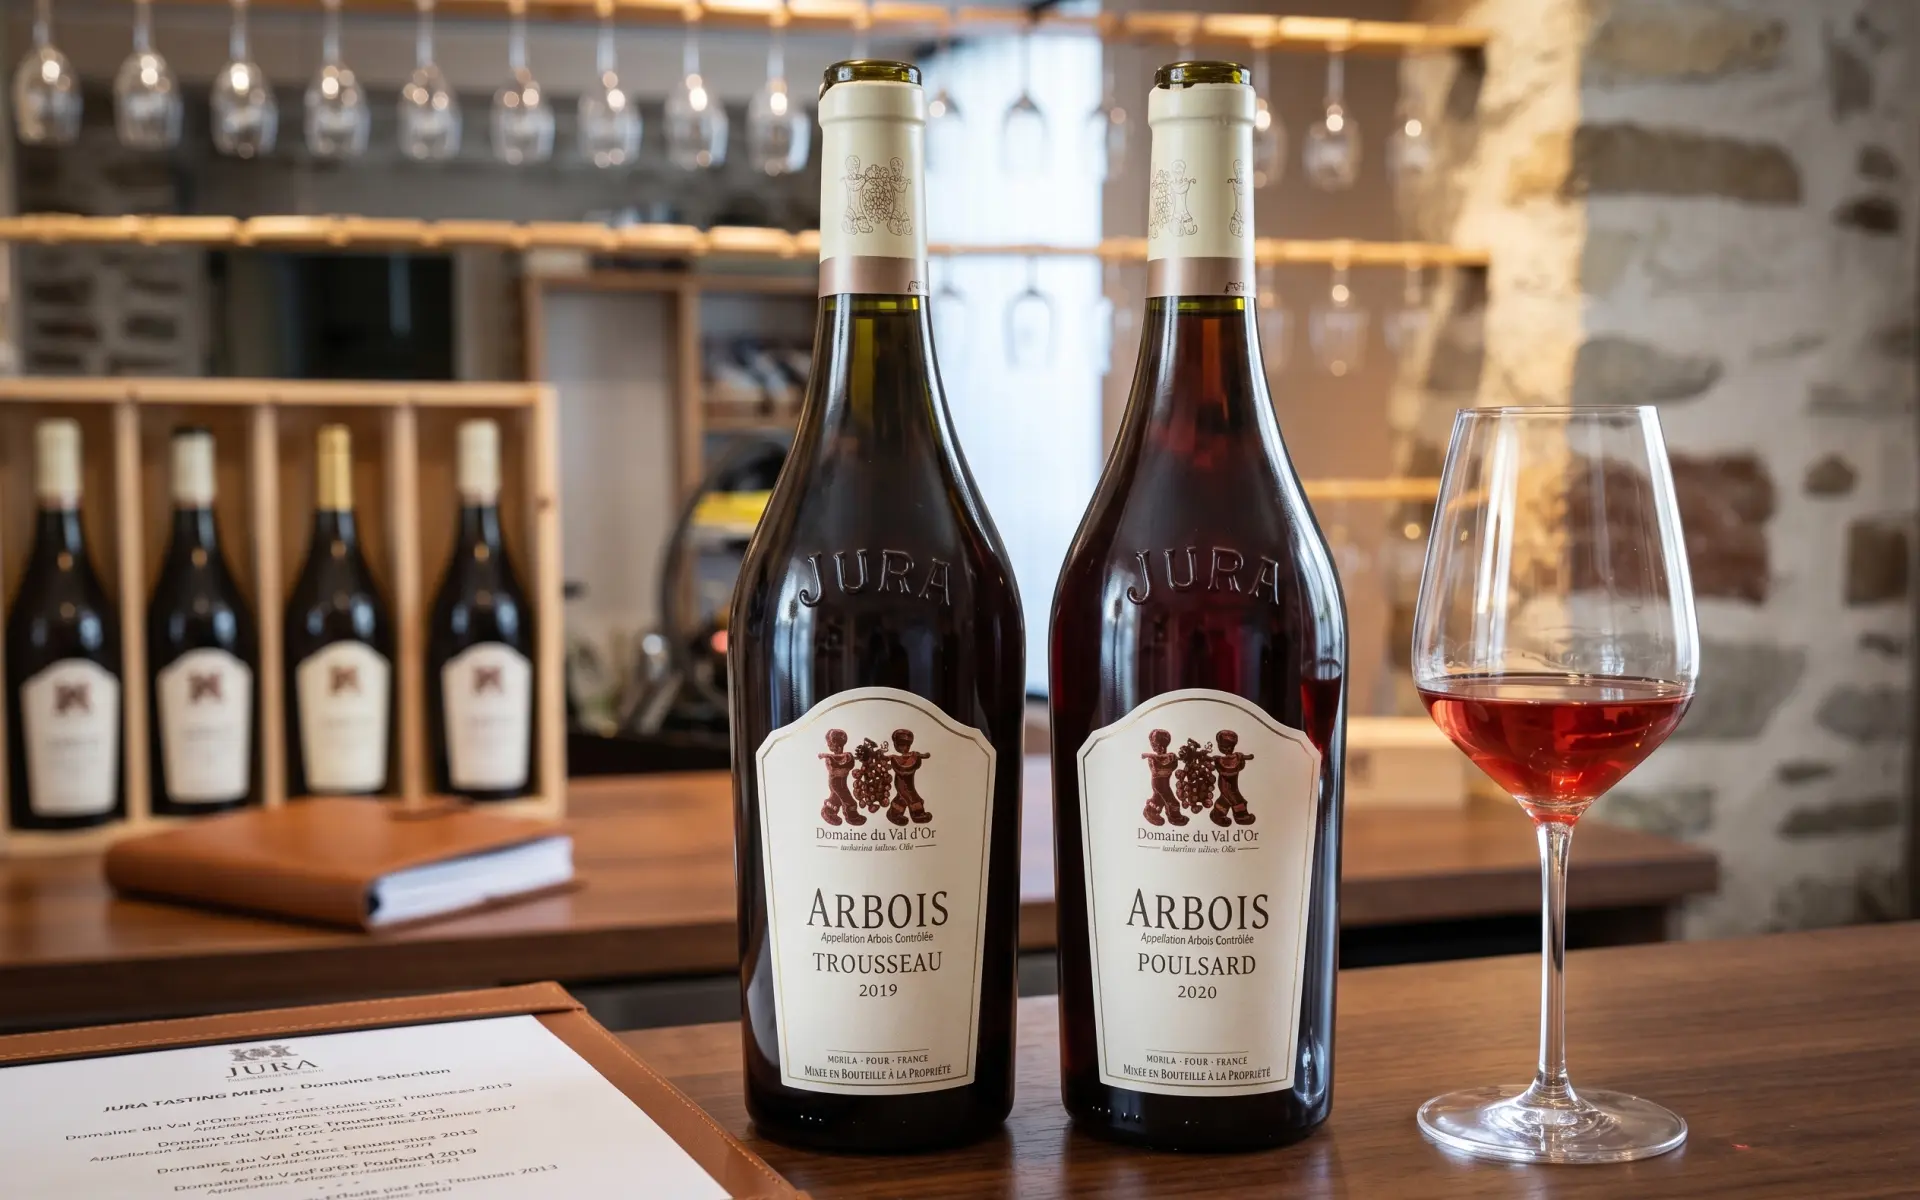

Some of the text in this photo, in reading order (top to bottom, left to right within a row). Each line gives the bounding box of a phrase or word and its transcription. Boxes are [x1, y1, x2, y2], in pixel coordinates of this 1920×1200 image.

[799, 548, 951, 608] JURA
[1126, 546, 1281, 606] JURA
[816, 827, 936, 840] Domaine du Val d'Or
[1138, 828, 1259, 843] Domaine du Val d'Or
[806, 887, 949, 929] ARBOIS
[1126, 888, 1269, 931] ARBOIS
[821, 931, 934, 945] Appellation Arbois Contrôlée
[1140, 932, 1254, 946] Appellation Arbois Contrôlée
[812, 951, 943, 974] TROUSSEAU
[1138, 953, 1256, 976] POULSARD
[859, 983, 898, 998] 2019
[1177, 985, 1217, 999] 2020
[866, 1056, 889, 1065] POUR
[897, 1054, 928, 1064] FRANCE
[1184, 1057, 1208, 1066] FOUR
[1216, 1056, 1248, 1066] FRANCE
[225, 1059, 318, 1078] JURA
[103, 1102, 148, 1112] JURA
[153, 1093, 226, 1106] TASTING
[232, 1086, 283, 1097] MENU
[301, 1076, 373, 1089] Domaine
[376, 1068, 451, 1082] Selection
[65, 1128, 136, 1141] Domaine
